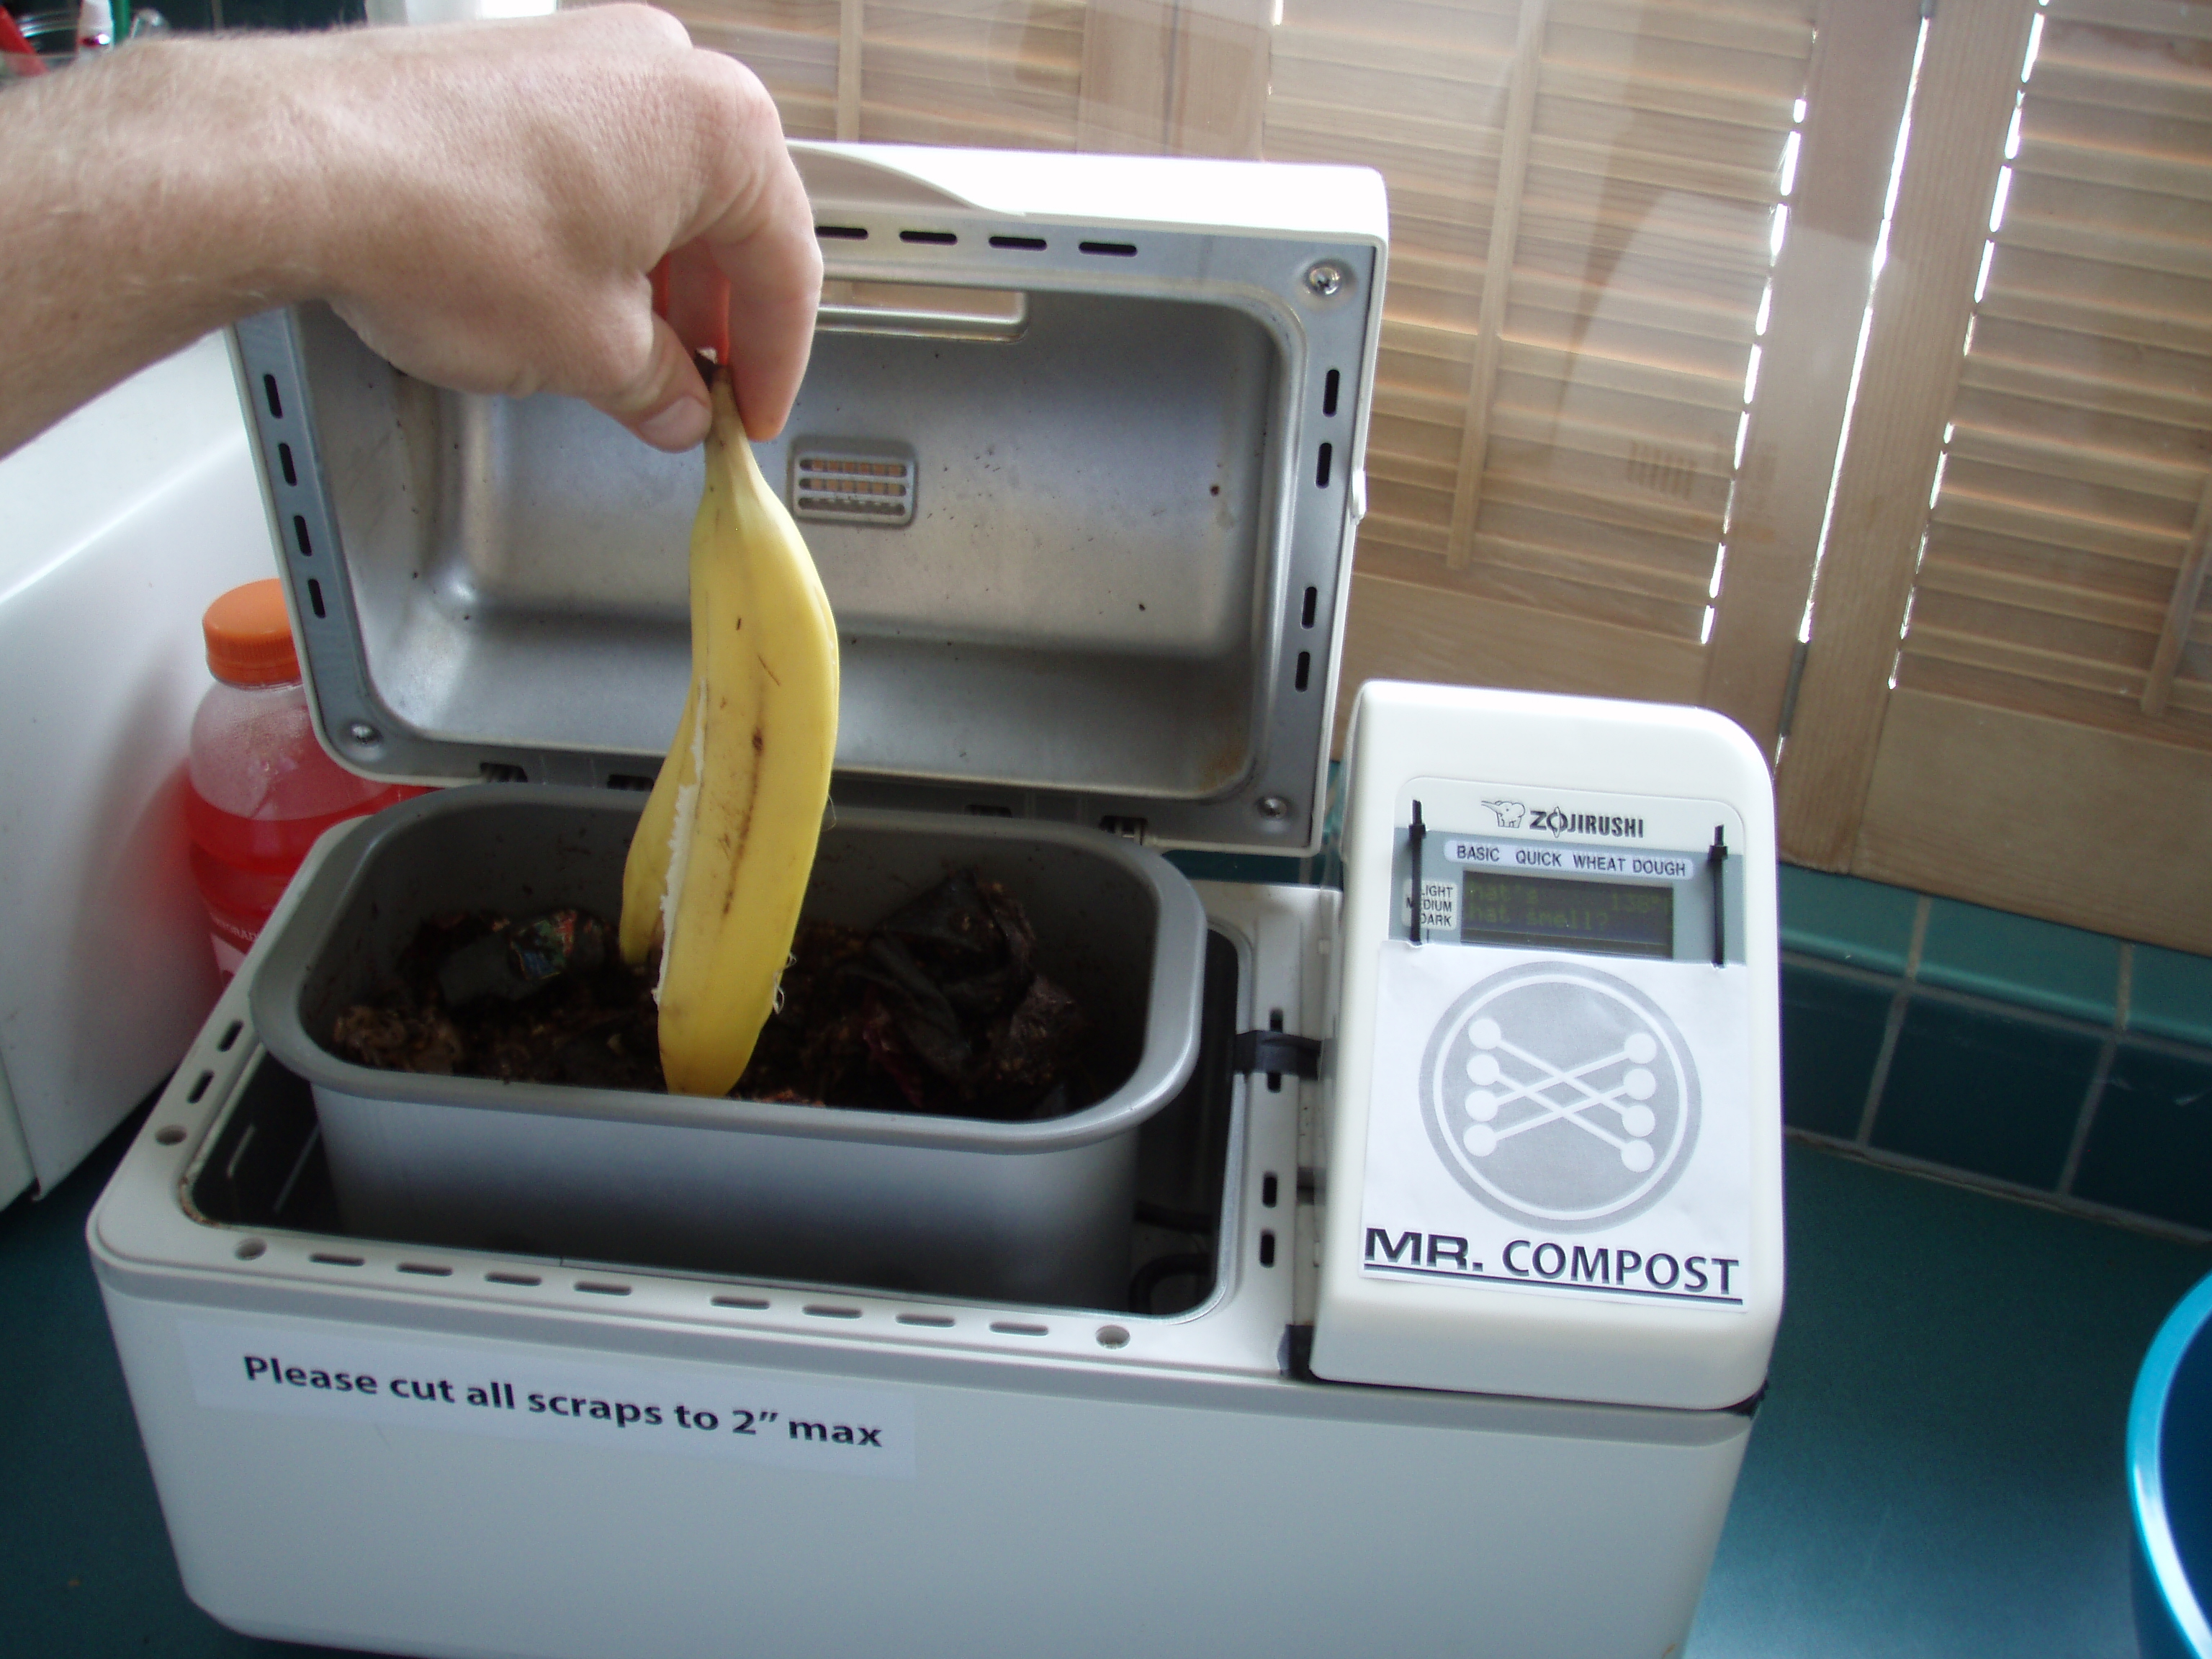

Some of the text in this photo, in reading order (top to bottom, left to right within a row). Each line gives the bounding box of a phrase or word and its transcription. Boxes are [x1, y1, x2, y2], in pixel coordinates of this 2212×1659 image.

[1529, 806, 1644, 838] ZOJIRUSHI
[1457, 845, 1685, 876] BASIC QUICK WHEAT DOUGH
[1406, 897, 1452, 912] MDIUM
[1421, 885, 1453, 898] IGHT
[1364, 1227, 1739, 1295] MR. COMPOST
[243, 1356, 378, 1395] Please
[389, 1378, 456, 1404] cut
[467, 1380, 516, 1410] all
[528, 1391, 663, 1427] scraps
[674, 1405, 719, 1431] to
[788, 1418, 883, 1447] max
